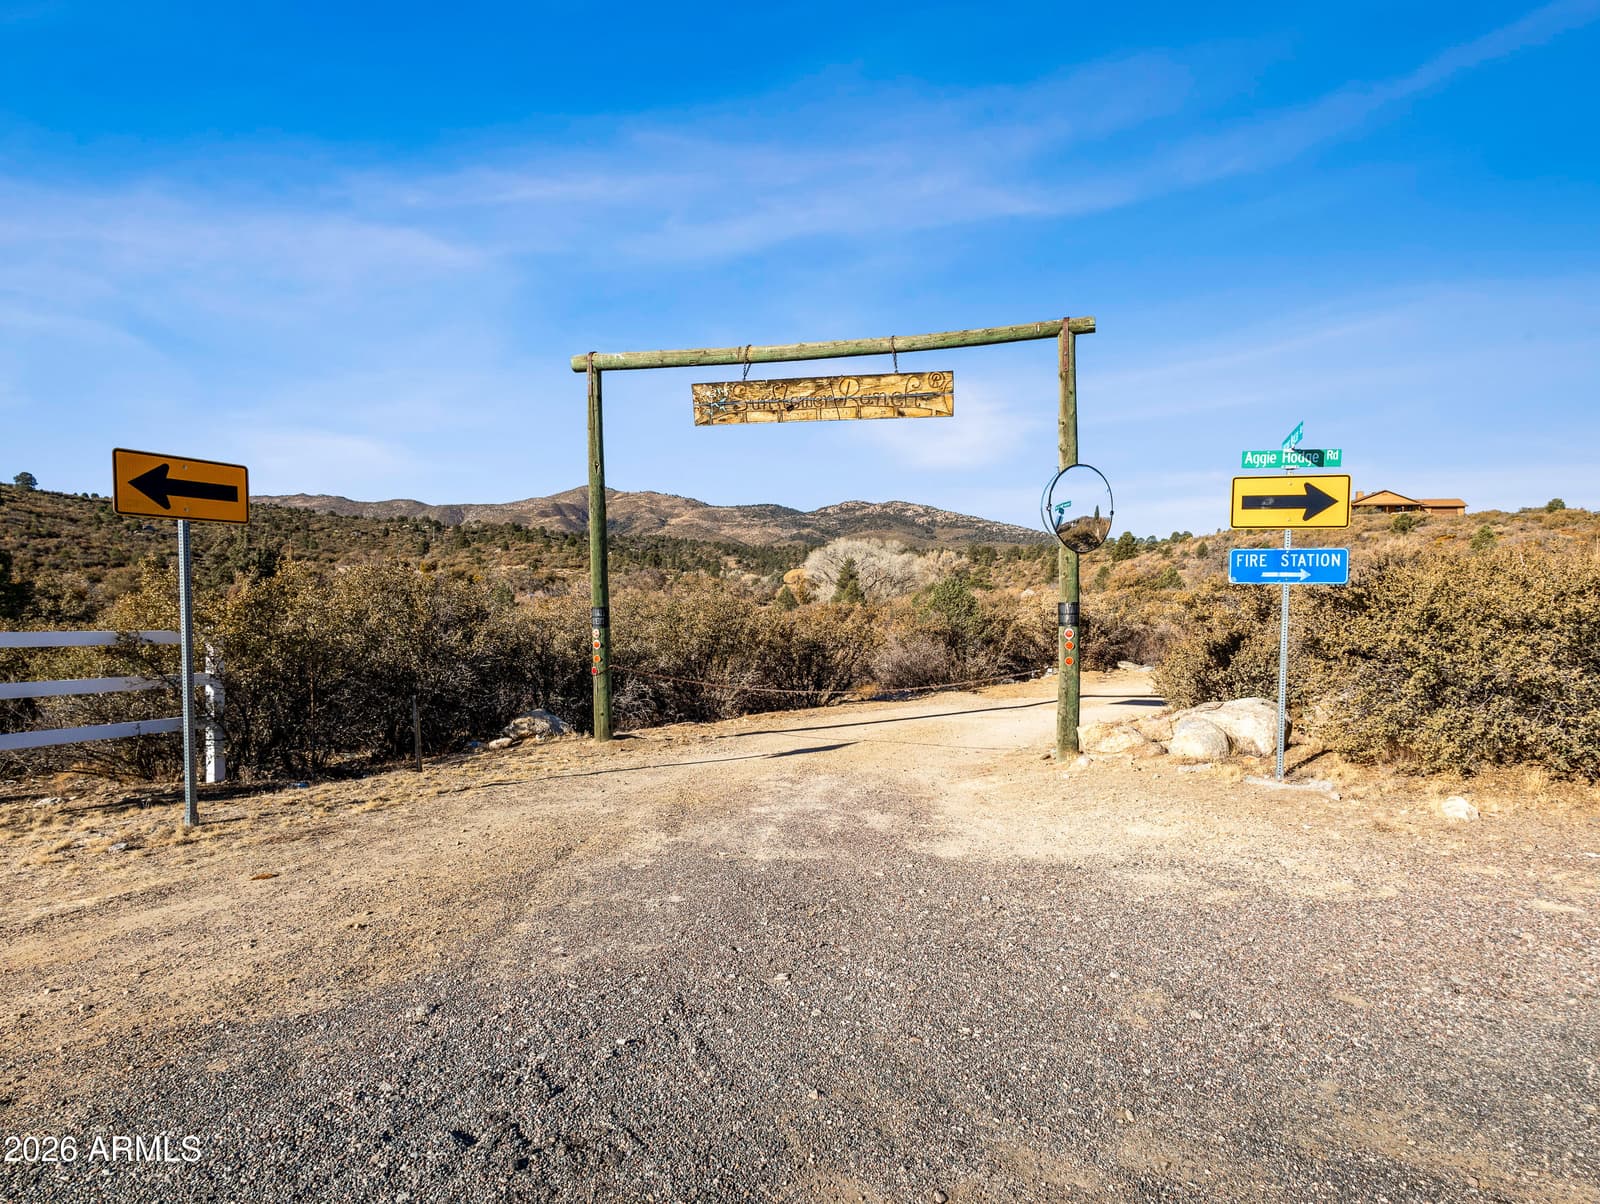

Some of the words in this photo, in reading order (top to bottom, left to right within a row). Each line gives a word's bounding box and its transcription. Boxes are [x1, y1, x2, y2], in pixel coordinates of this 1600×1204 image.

[839, 376, 921, 408] Ranch
[1245, 451, 1277, 467] Aggie
[1282, 451, 1319, 466] Hodge
[1327, 450, 1339, 460] Rd
[1236, 554, 1267, 567] FIRE
[1281, 553, 1341, 567] STATION
